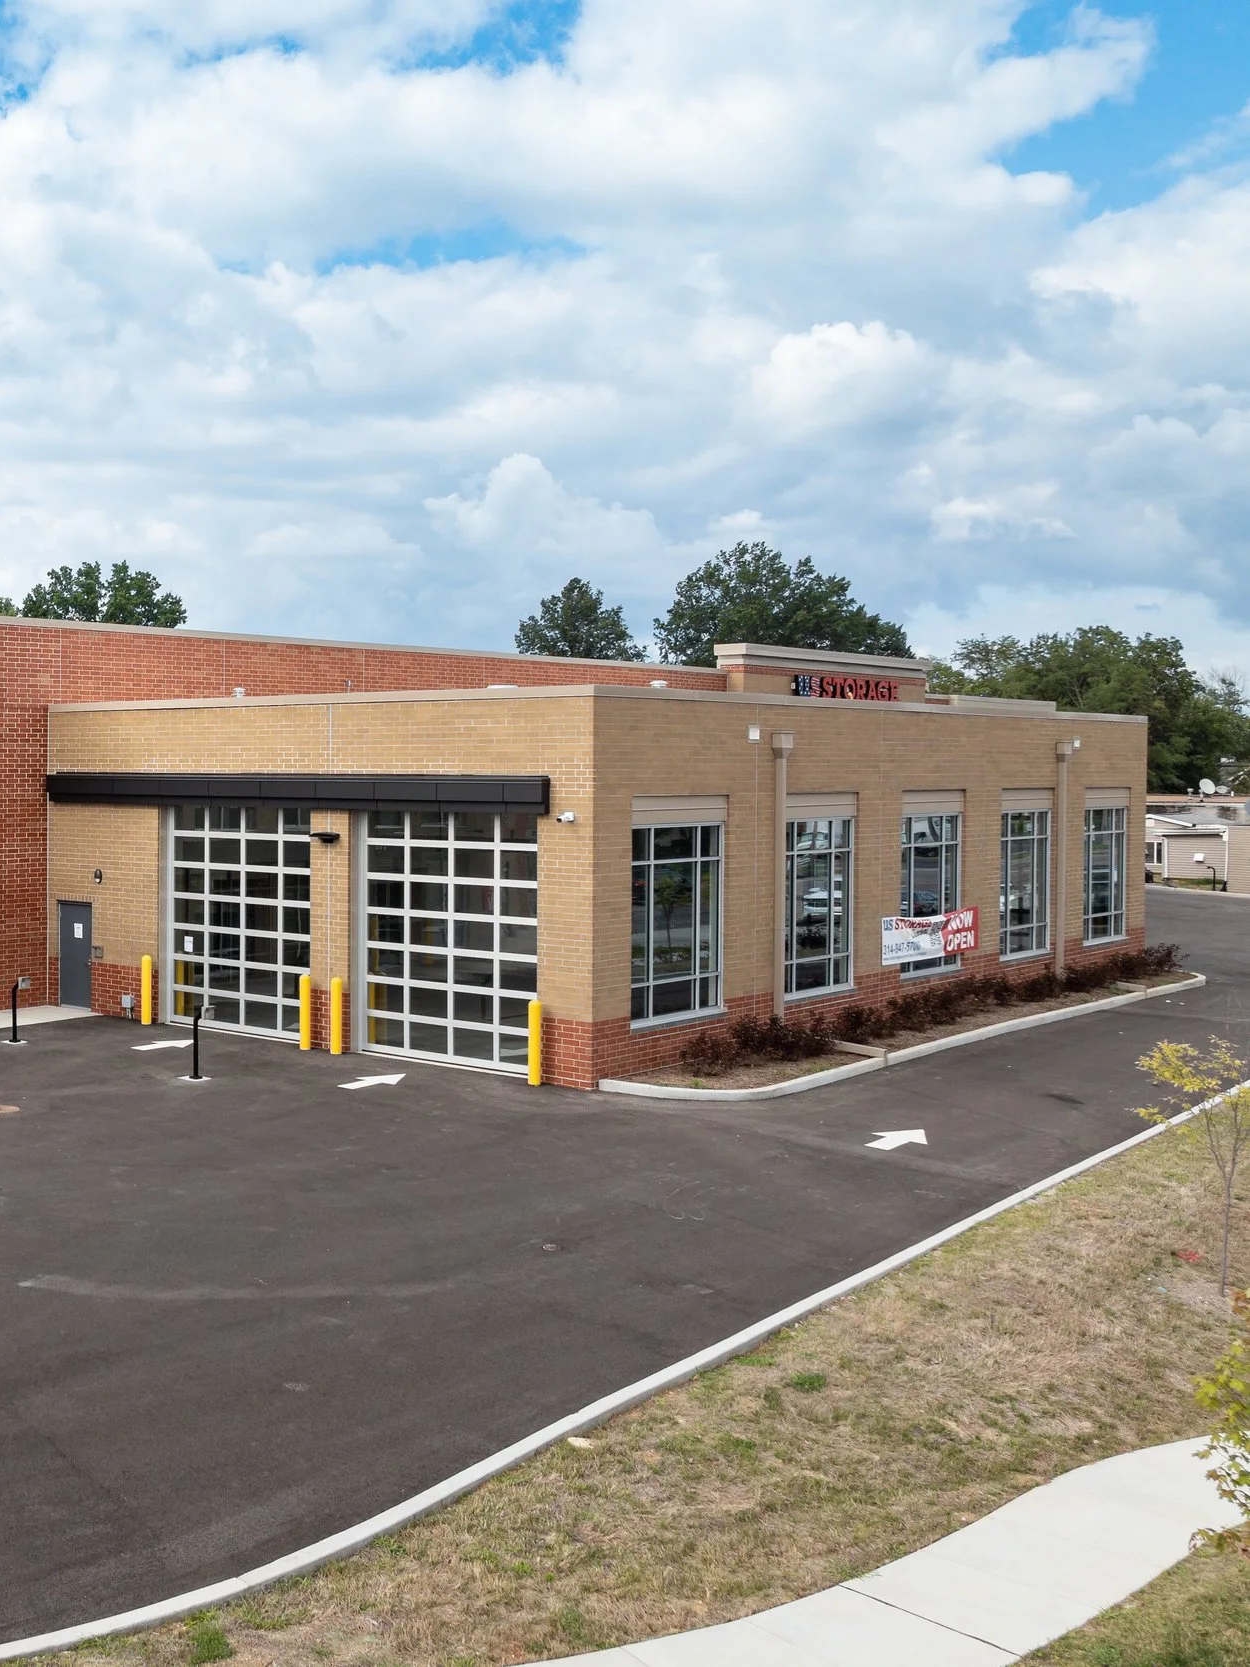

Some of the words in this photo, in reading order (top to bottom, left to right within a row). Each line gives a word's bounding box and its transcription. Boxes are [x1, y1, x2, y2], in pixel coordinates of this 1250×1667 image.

[795, 674, 821, 698] US
[822, 676, 902, 702] STORAGE
[882, 919, 894, 931] US
[947, 910, 974, 931] NOW
[946, 930, 975, 952] OPEN
